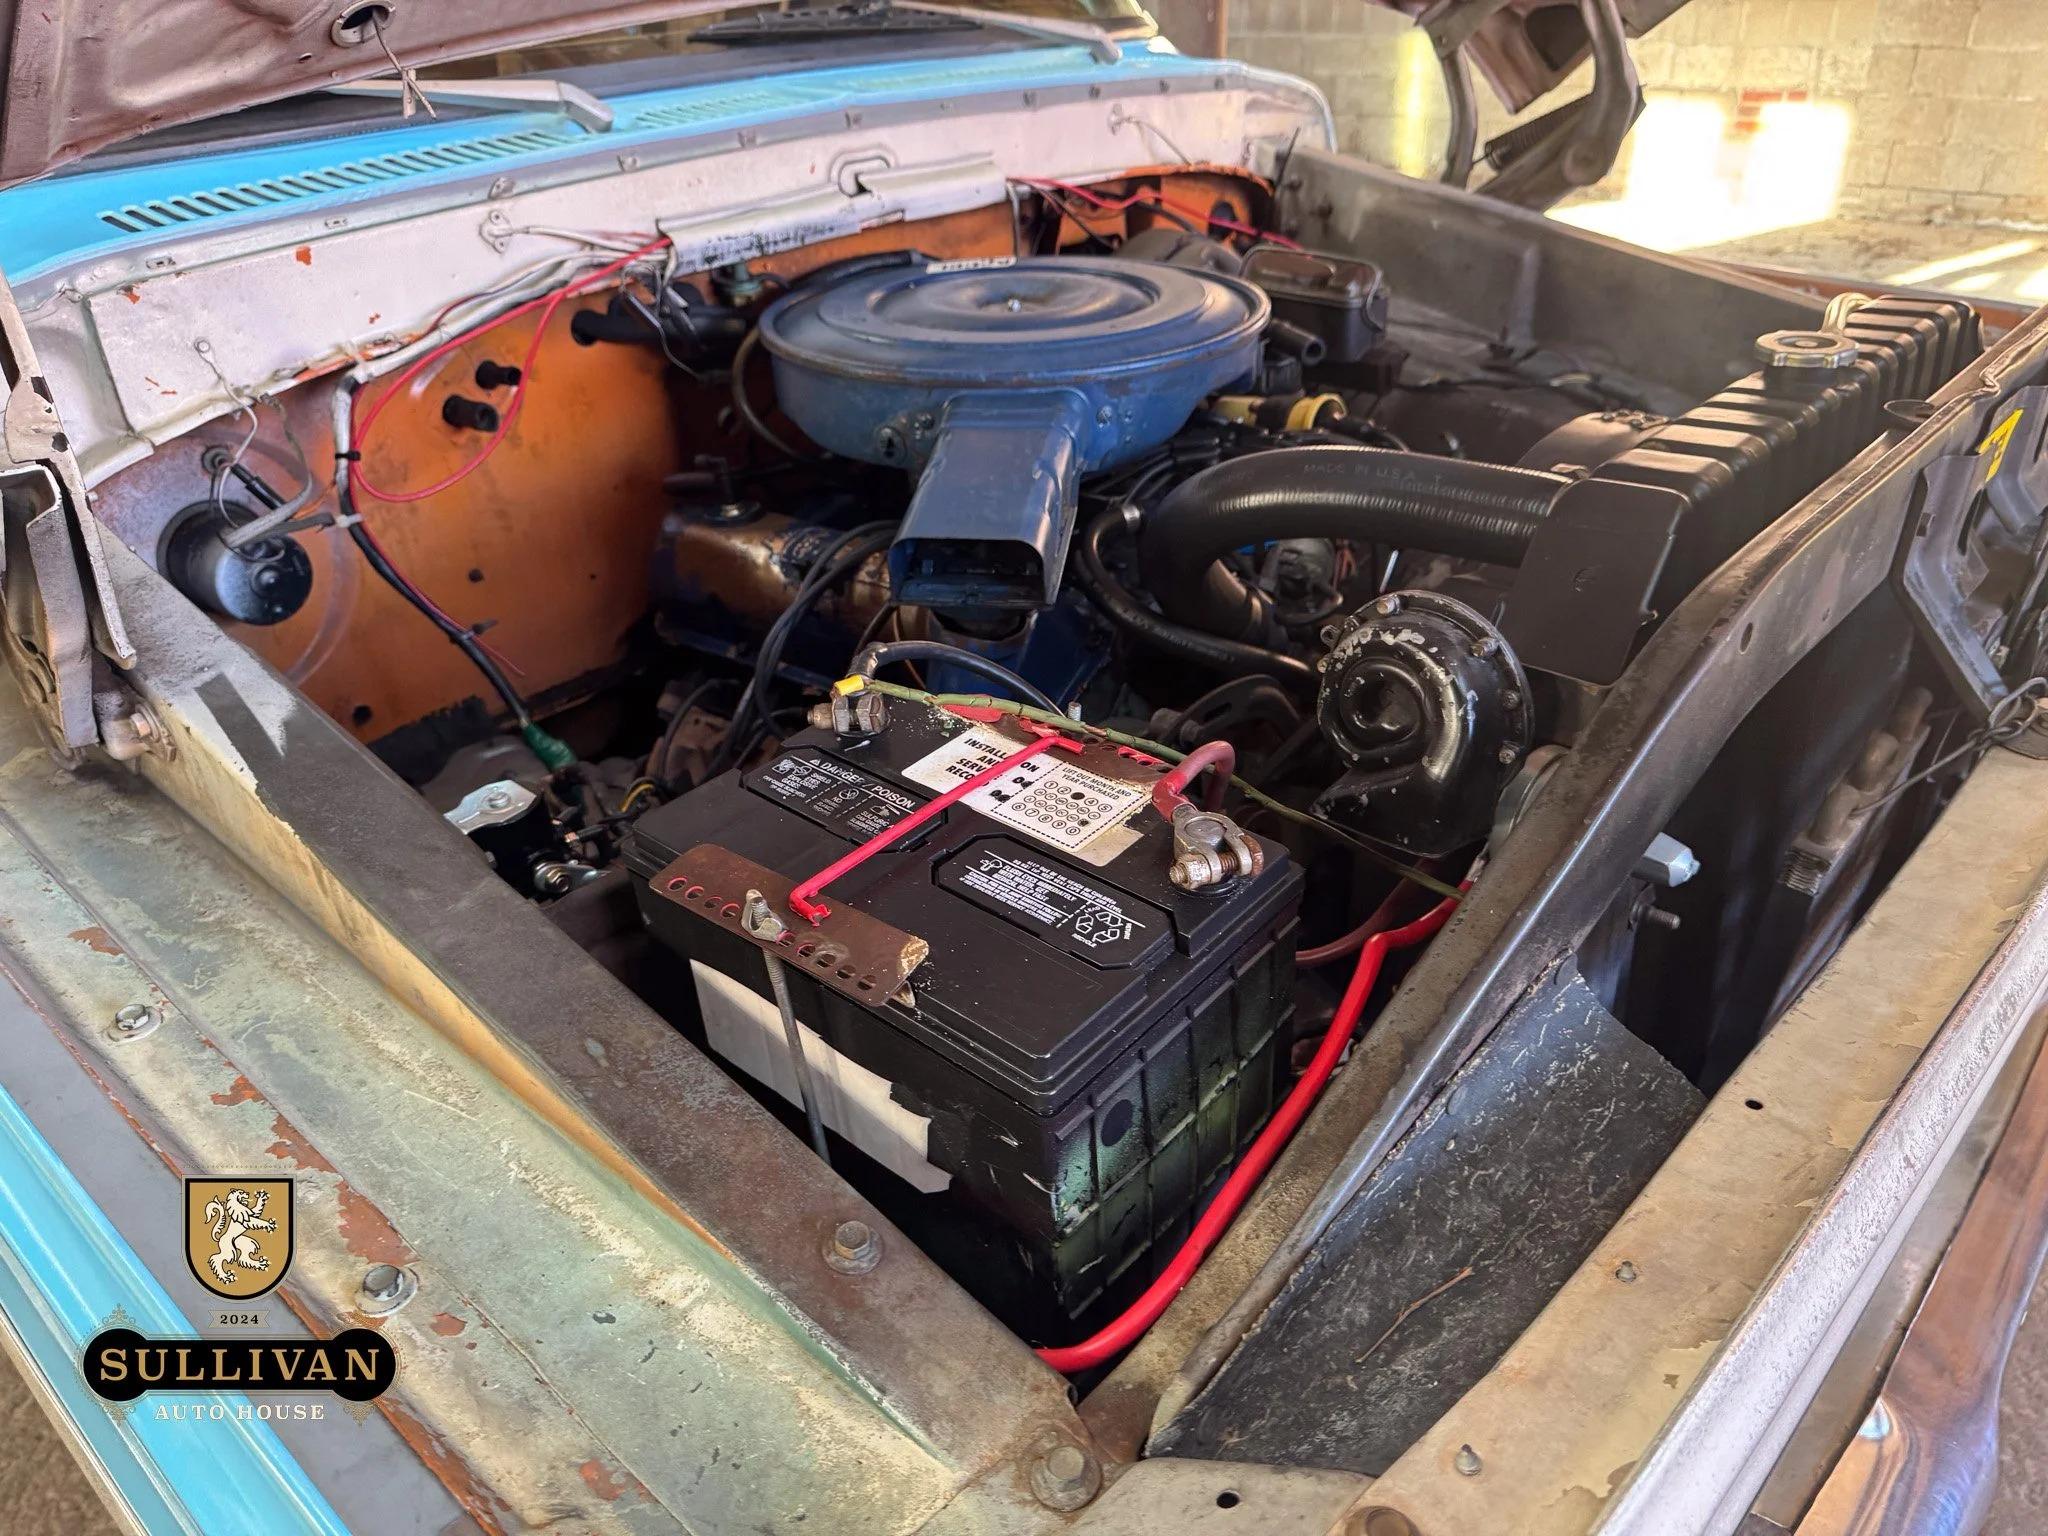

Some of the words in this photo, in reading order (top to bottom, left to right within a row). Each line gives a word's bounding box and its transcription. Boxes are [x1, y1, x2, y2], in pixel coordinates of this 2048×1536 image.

[1062, 767, 1077, 775] LIFT
[1092, 778, 1116, 791] MONTH
[1116, 789, 1132, 797] AND
[1062, 774, 1080, 784] YEAR
[1079, 781, 1120, 800] PURCHASED
[871, 785, 915, 809] POISON
